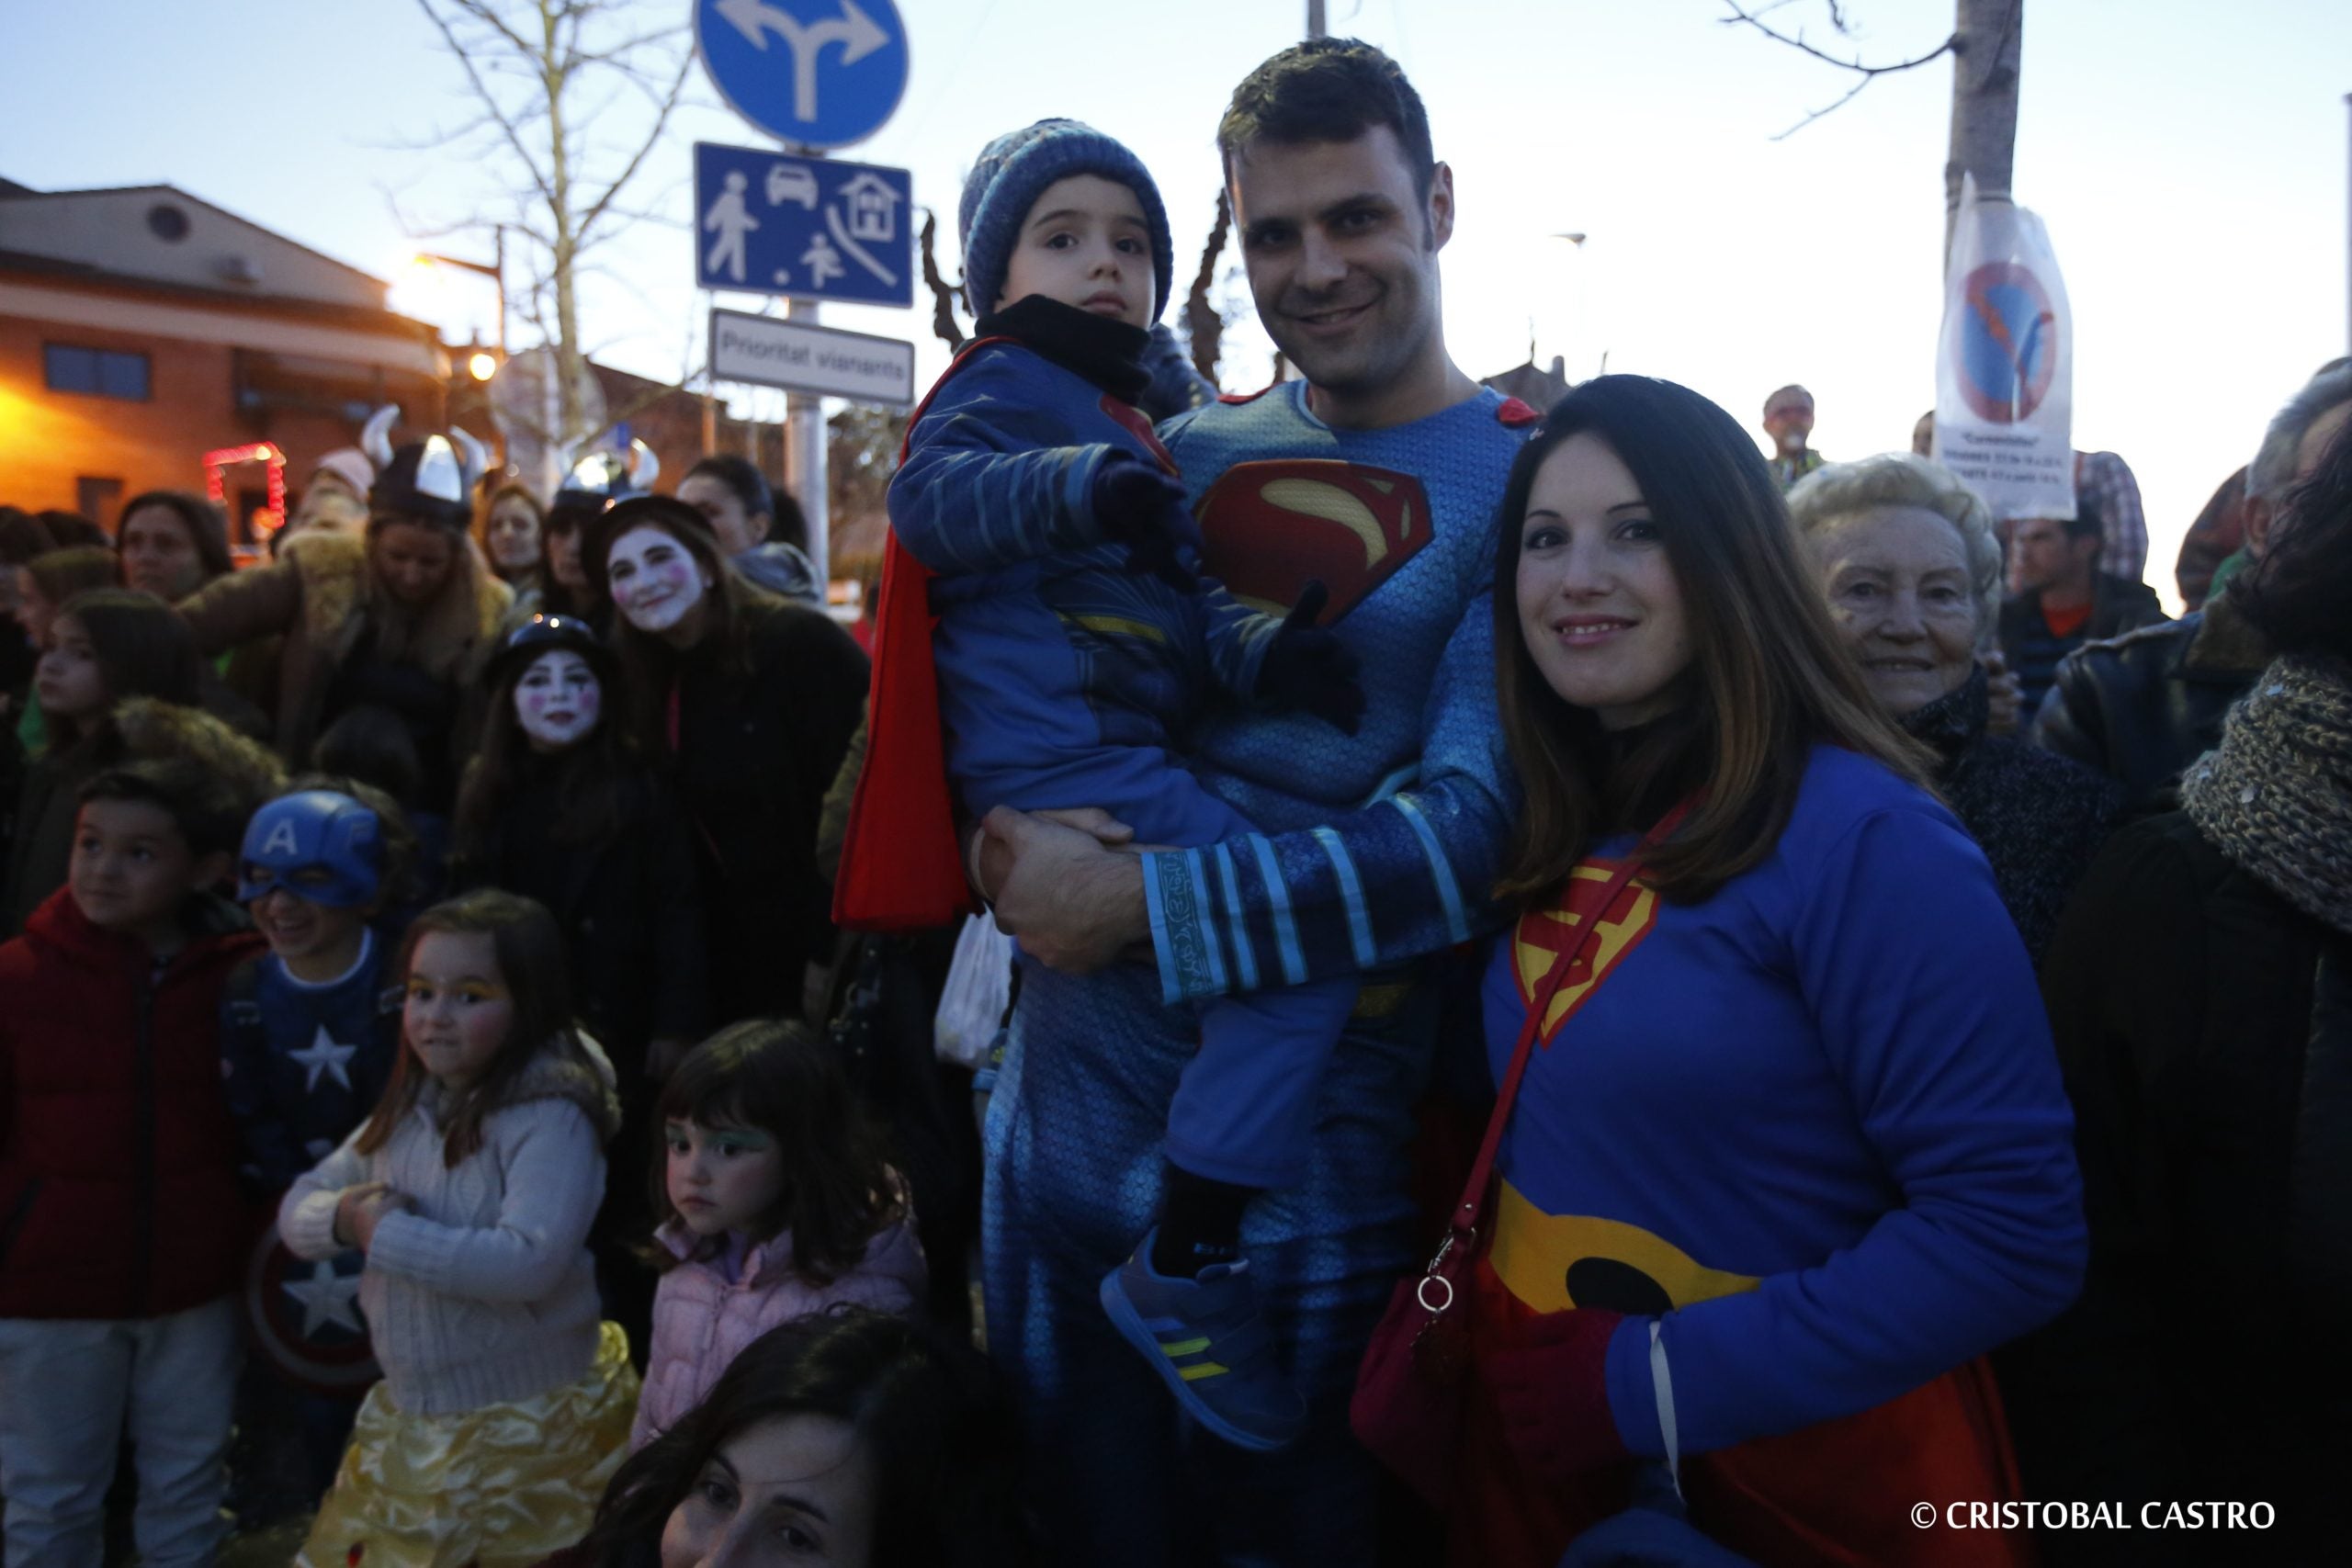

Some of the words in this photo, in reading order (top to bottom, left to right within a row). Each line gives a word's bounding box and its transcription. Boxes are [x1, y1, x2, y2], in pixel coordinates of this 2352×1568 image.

[721, 329, 809, 366] Prioritat
[817, 351, 905, 382] vianants
[261, 817, 299, 856] A
